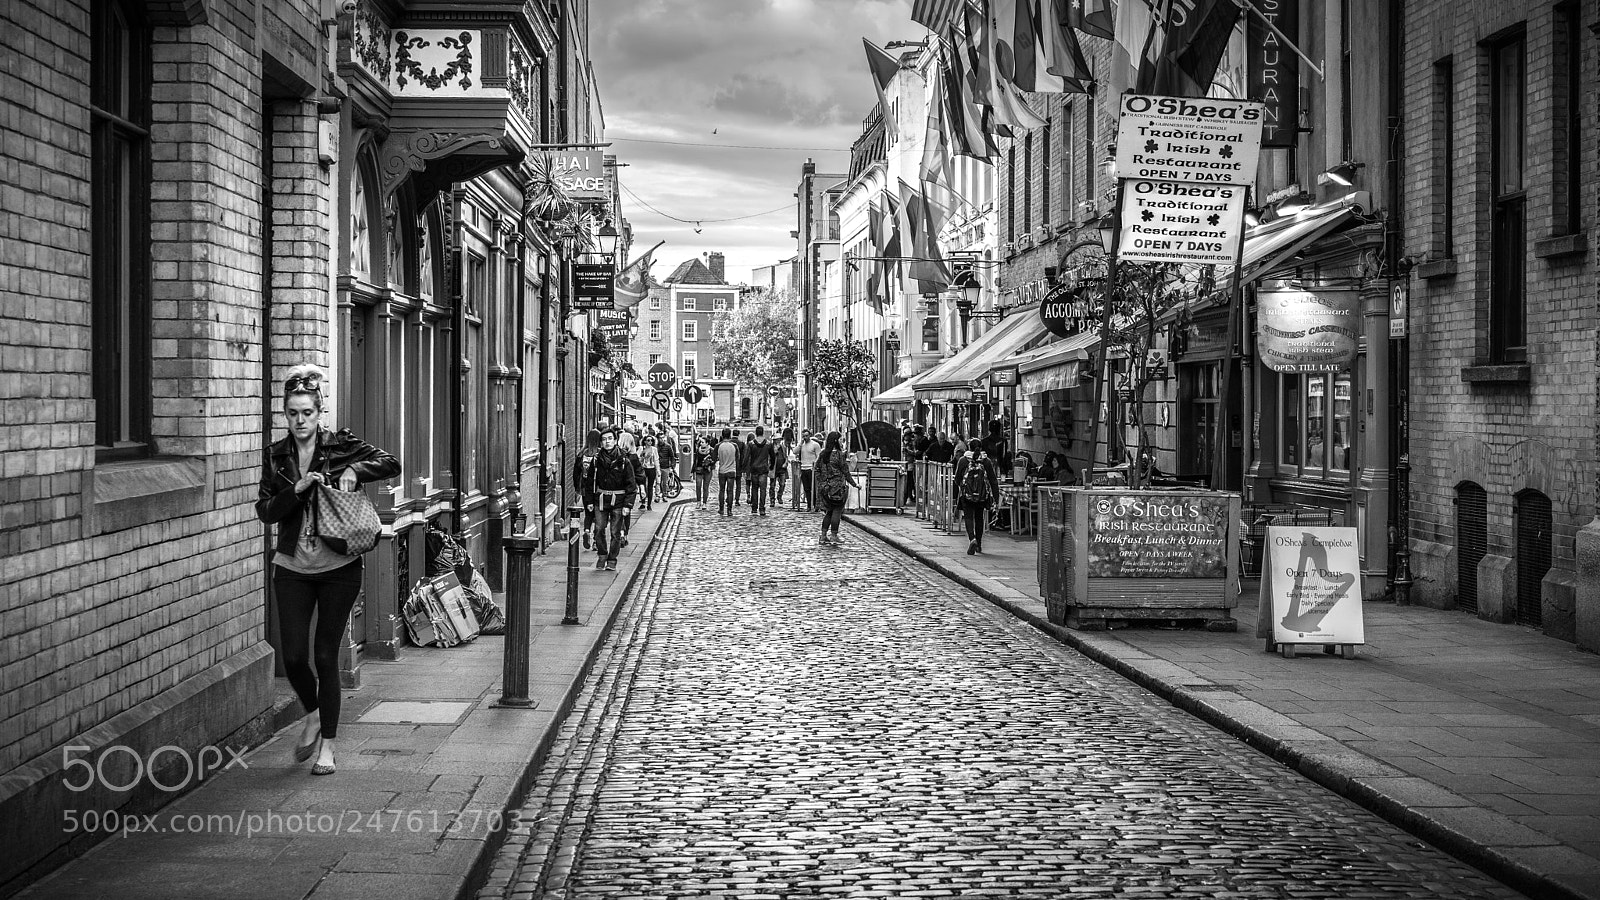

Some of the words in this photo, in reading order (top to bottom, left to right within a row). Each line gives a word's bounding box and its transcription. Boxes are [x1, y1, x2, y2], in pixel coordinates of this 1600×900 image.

[1126, 96, 1260, 120] O'Shea's
[1138, 126, 1243, 143] Traditional
[1166, 143, 1211, 155] Irish
[555, 156, 589, 171] HAI
[1132, 154, 1242, 171] Restaurant
[1139, 169, 1178, 179] OPEN
[1182, 172, 1191, 180] 7
[1195, 172, 1232, 182] DAYS
[1134, 181, 1233, 199] O'Shea's
[1135, 198, 1228, 211] Traditional
[1161, 213, 1200, 224] Irish
[1132, 224, 1227, 239] Restaurant
[1133, 238, 1171, 250] OPEN
[1175, 241, 1183, 250] 7
[1187, 241, 1222, 252] DAYS
[1122, 250, 1232, 261] www.osheasirishrestaurant.com
[1047, 291, 1059, 302] THE
[600, 309, 627, 320] MUSIC
[1267, 348, 1297, 361] CHICKEN
[649, 372, 675, 382] STOP
[1145, 535, 1176, 544] Lunch
[1178, 536, 1186, 545] &
[1188, 536, 1223, 545] Dinner
[1285, 567, 1308, 578] Open
[1311, 569, 1317, 577] 7
[1320, 568, 1343, 580] Days
